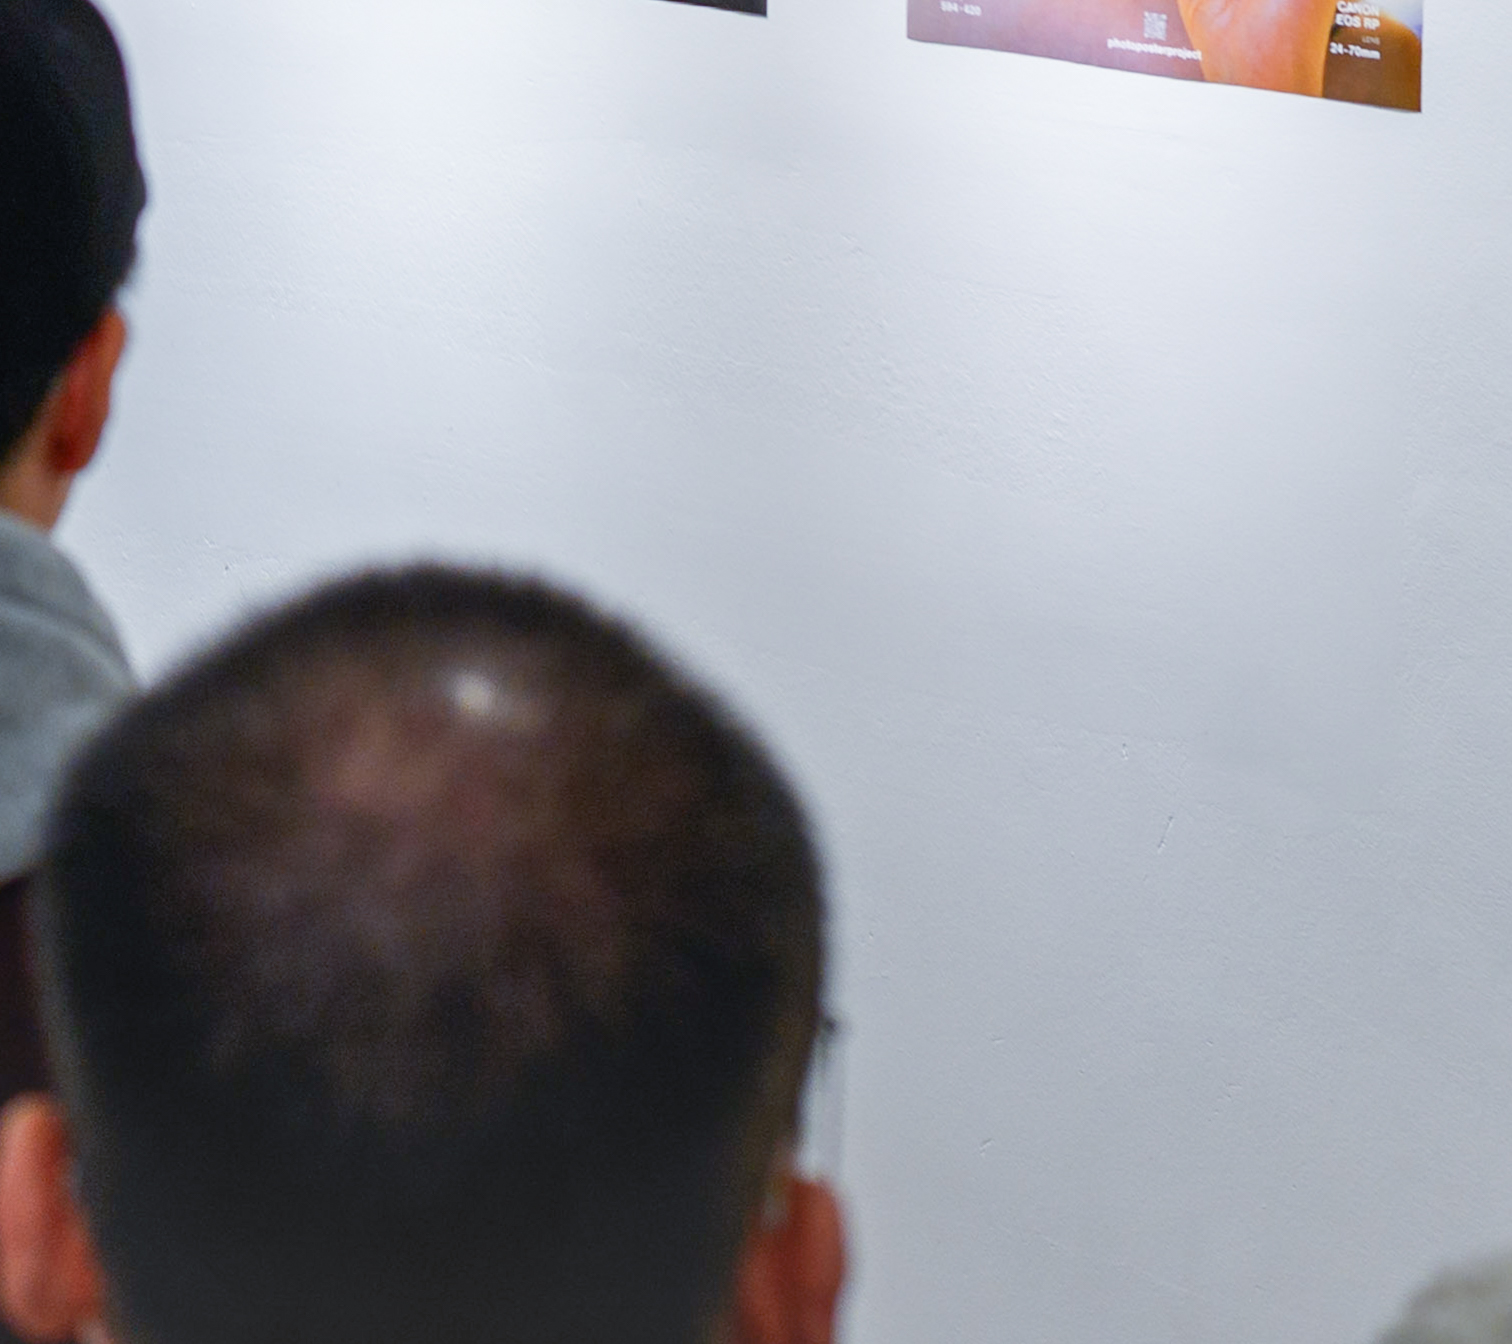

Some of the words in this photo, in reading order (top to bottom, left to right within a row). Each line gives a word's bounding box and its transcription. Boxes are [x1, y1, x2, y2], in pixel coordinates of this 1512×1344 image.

[1337, 0, 1380, 17] CANON
[1335, 13, 1362, 28] EOS
[1363, 17, 1380, 30] RP
[1107, 37, 1202, 61] photoposterproject
